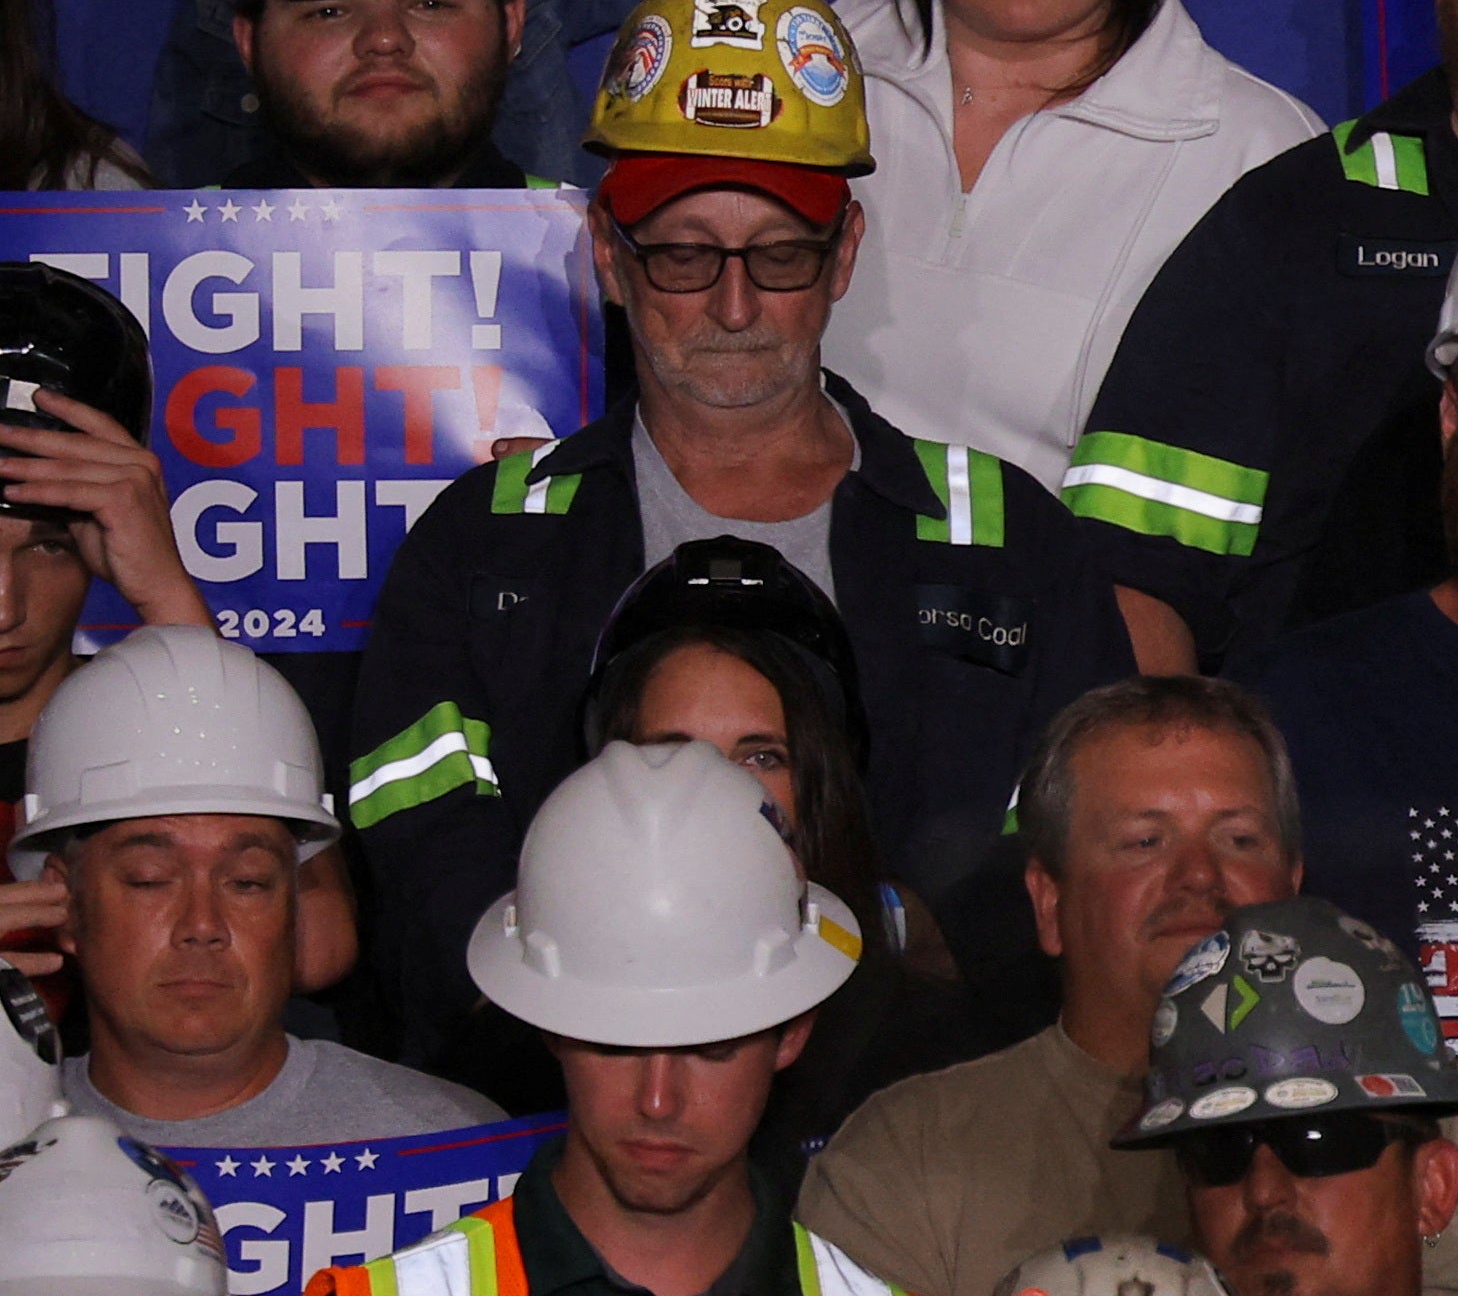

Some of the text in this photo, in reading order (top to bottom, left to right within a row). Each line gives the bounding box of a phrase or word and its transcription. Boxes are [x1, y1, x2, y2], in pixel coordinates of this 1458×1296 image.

[687, 88, 773, 110] WINTER ALERT
[1358, 245, 1439, 270] Logan
[218, 609, 326, 639] 2024
[979, 617, 1028, 646] Coal
